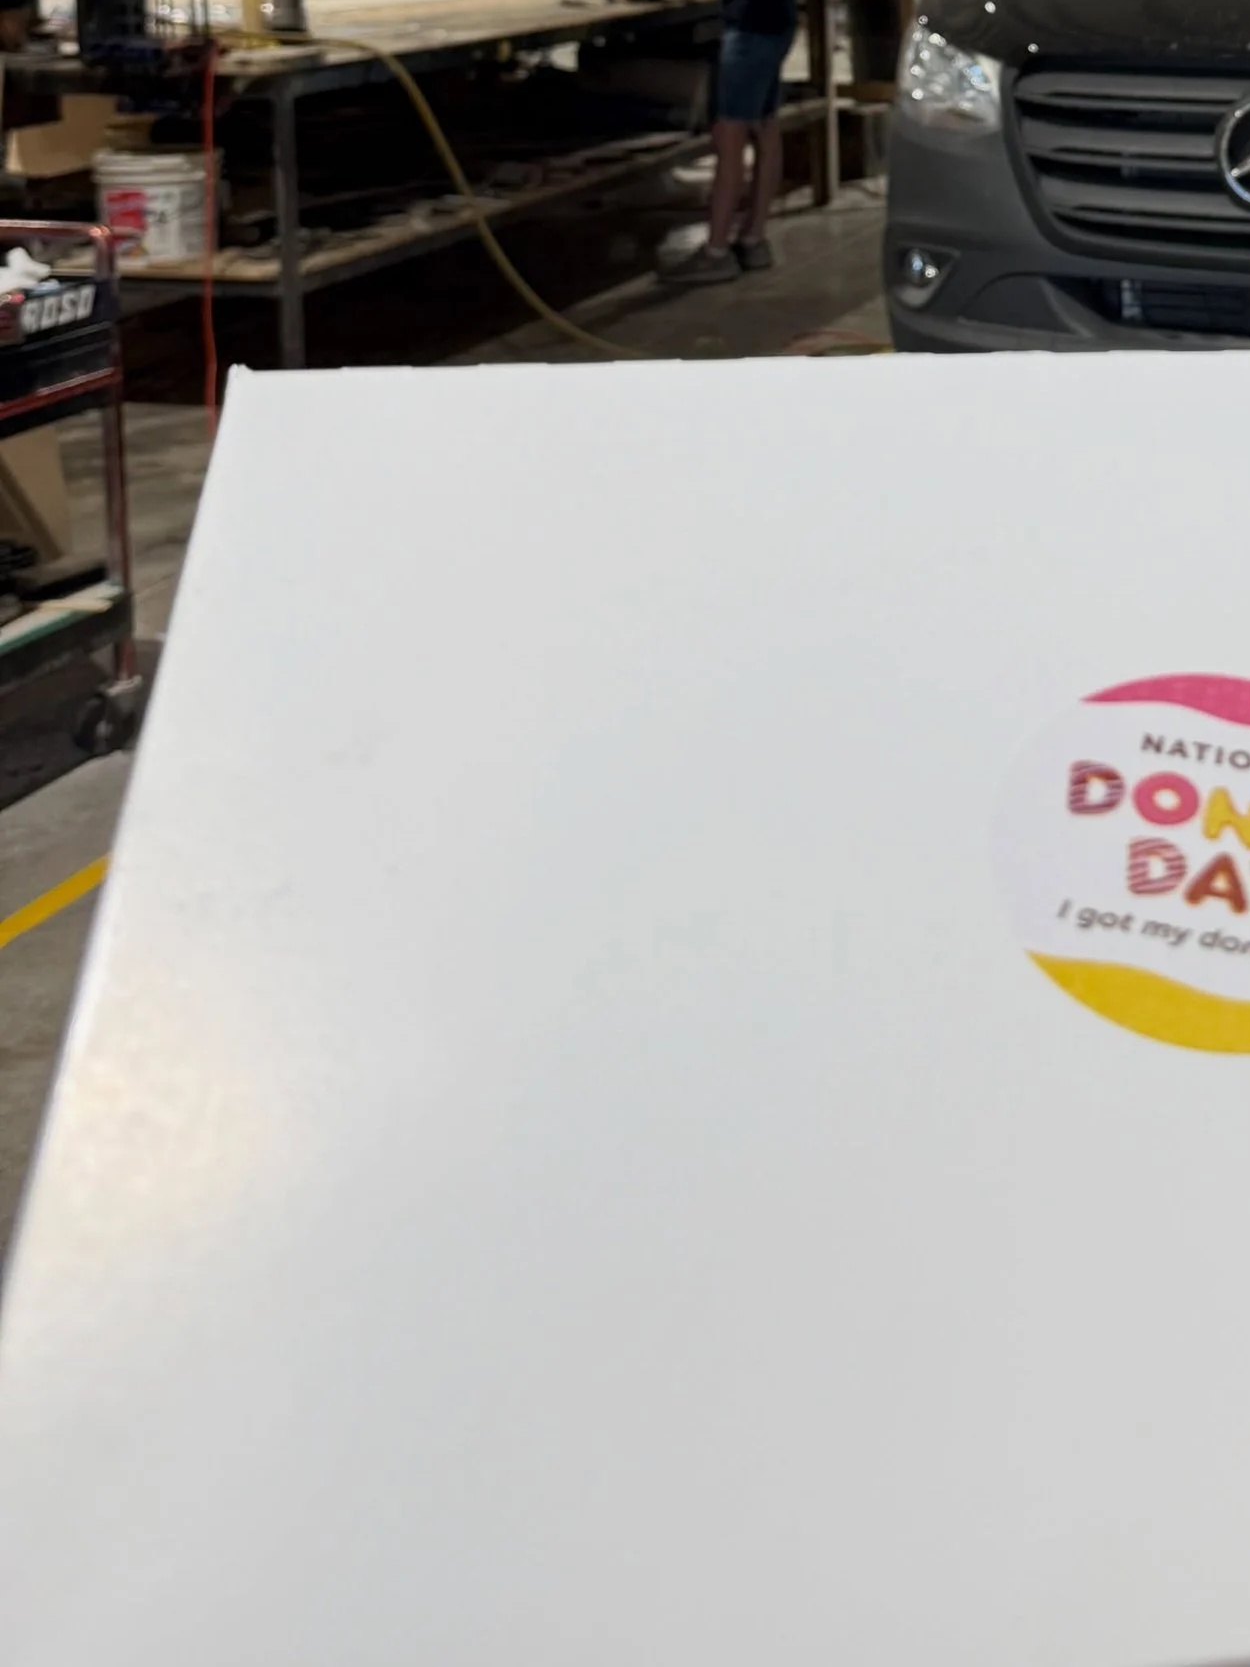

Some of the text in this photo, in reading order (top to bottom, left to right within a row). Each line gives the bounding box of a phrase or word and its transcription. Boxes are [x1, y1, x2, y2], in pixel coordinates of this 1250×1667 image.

[1055, 898, 1072, 920] I
[1075, 904, 1135, 932] got
[1139, 917, 1194, 948] my
